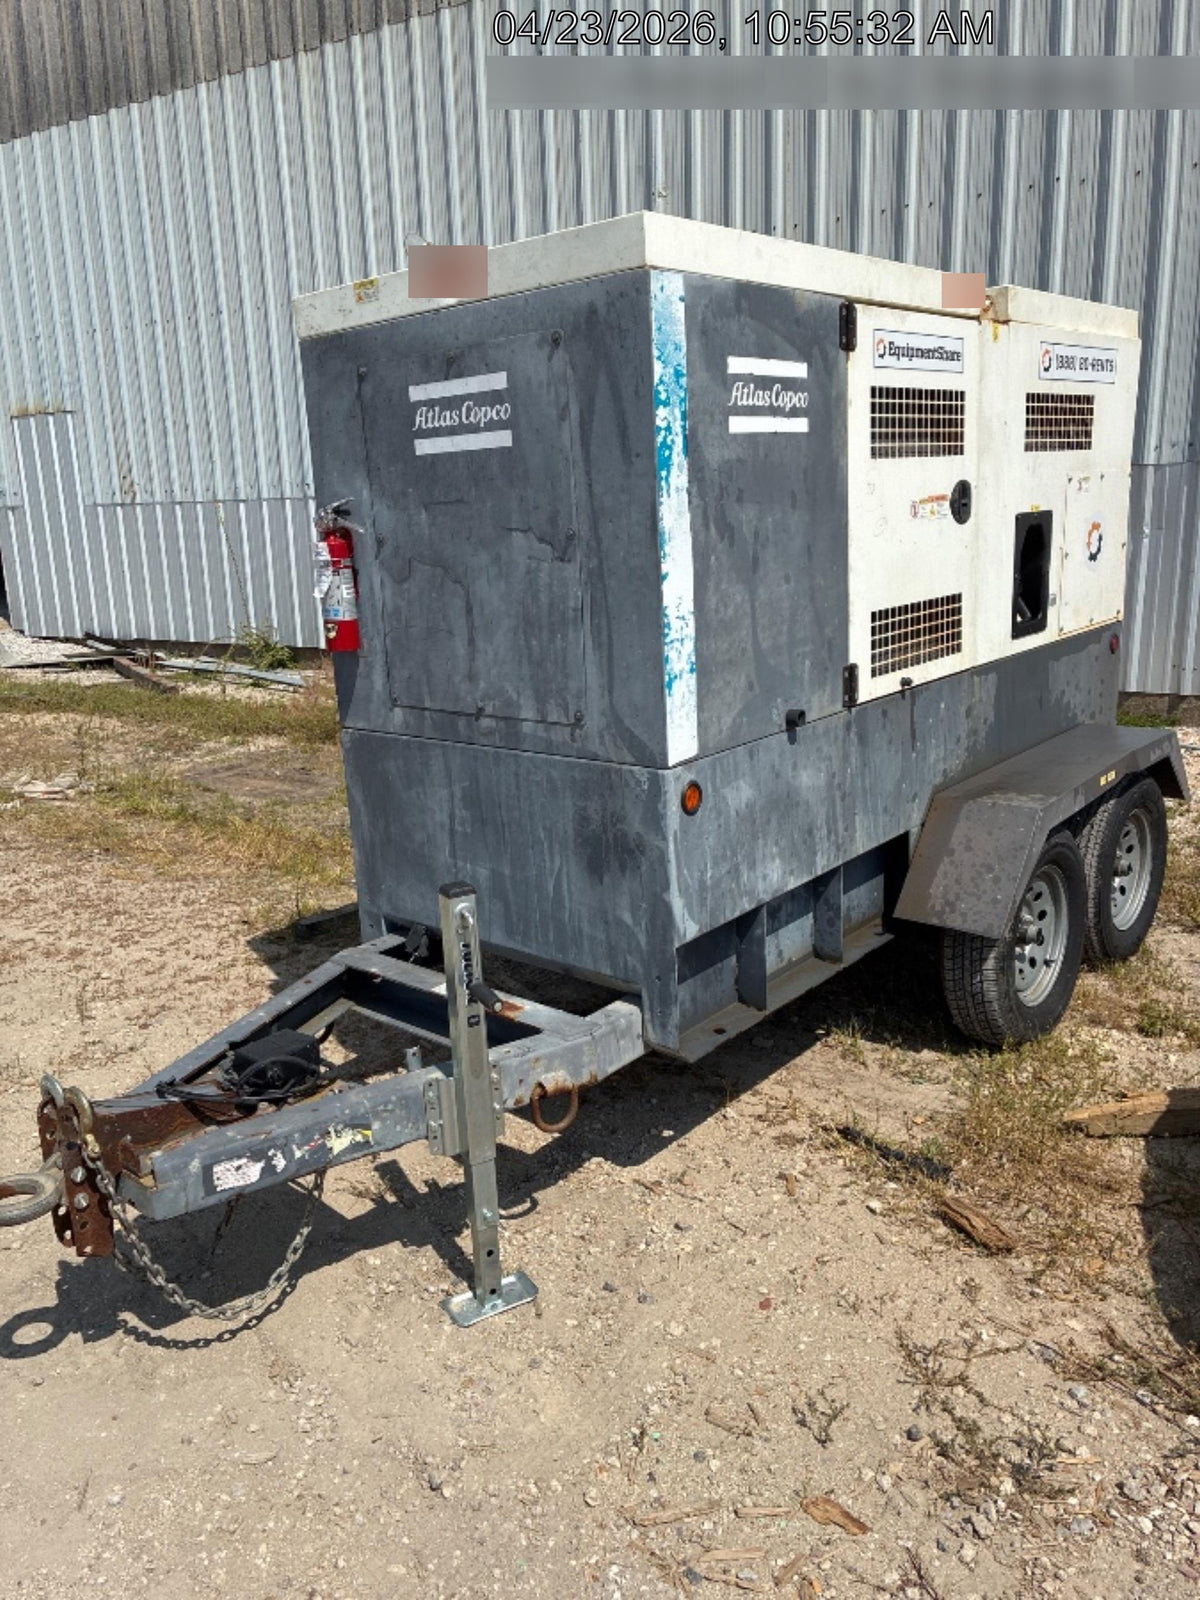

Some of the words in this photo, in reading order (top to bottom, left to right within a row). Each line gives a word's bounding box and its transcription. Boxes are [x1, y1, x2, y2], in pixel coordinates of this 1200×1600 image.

[888, 340, 961, 361] EquipmentShare
[728, 381, 771, 406] Atlas
[771, 383, 809, 412] Copco
[412, 404, 460, 431] Atlas
[461, 400, 511, 427] Copco
